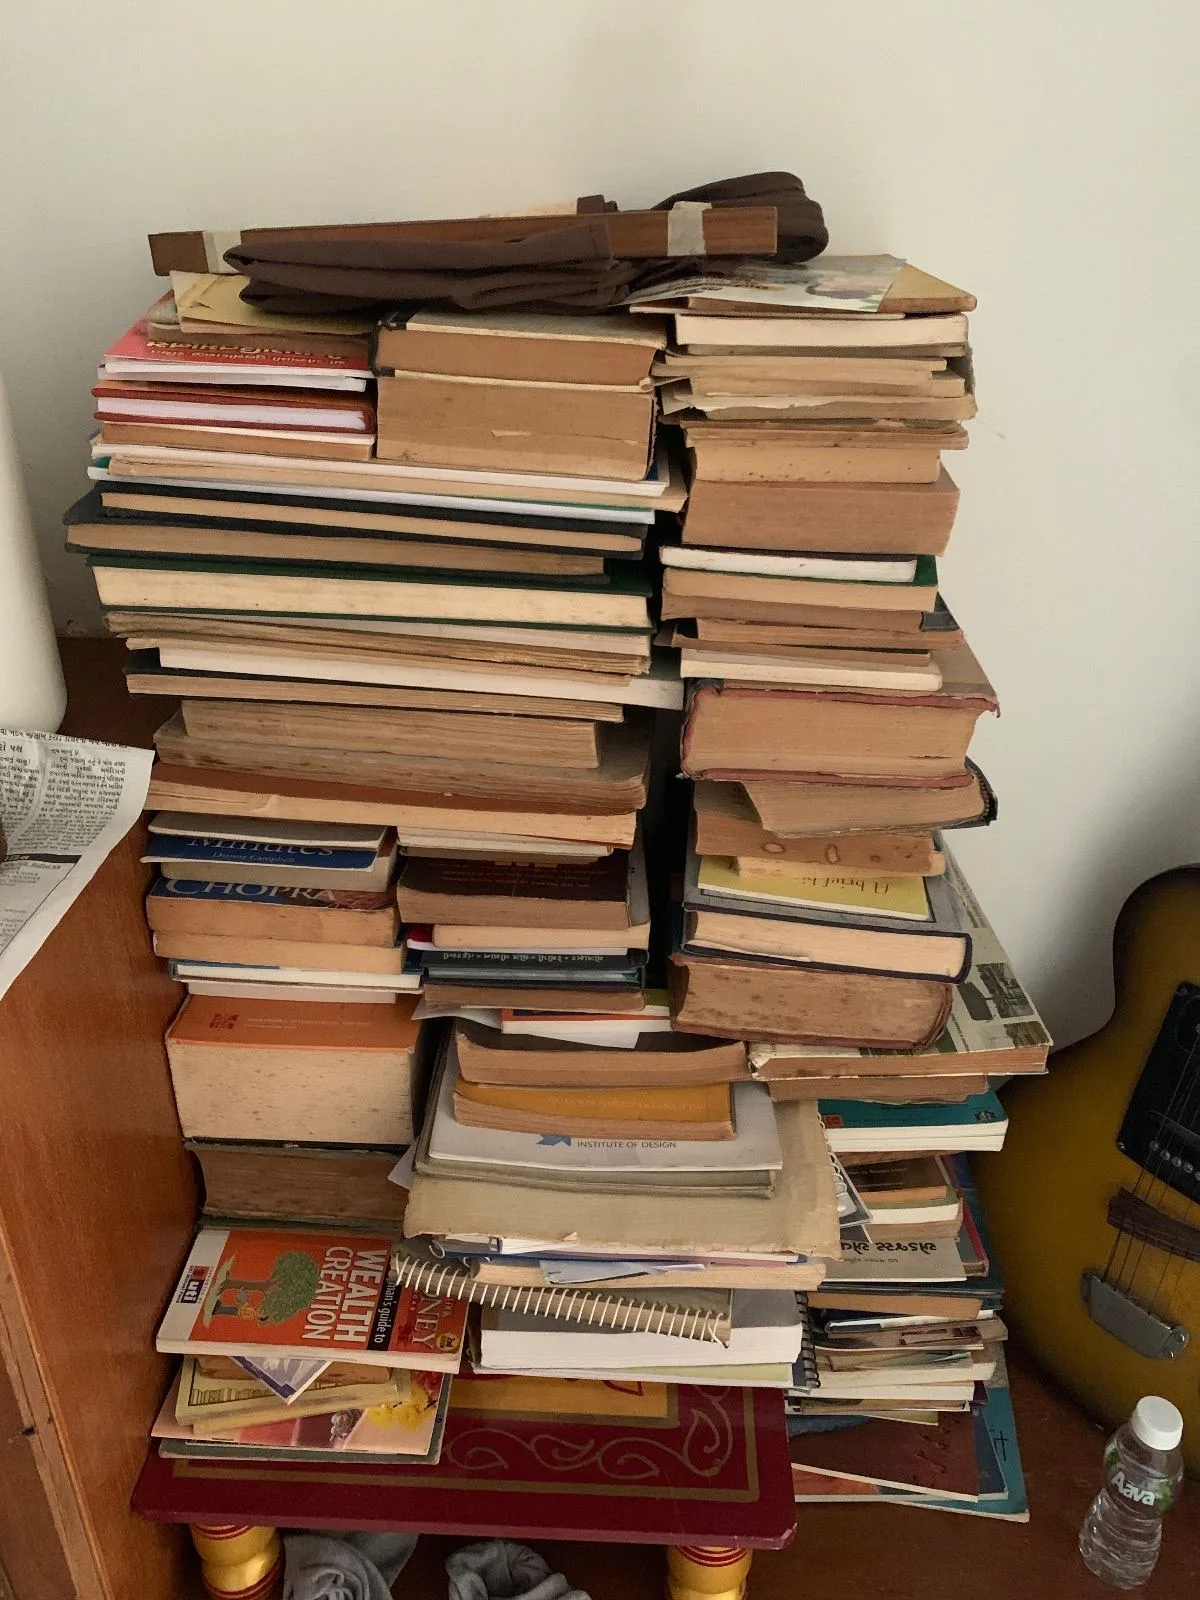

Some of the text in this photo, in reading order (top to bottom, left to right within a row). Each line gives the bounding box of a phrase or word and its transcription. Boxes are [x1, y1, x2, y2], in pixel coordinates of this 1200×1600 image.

[166, 879, 337, 901] CHOPRA
[577, 1141, 677, 1149] INSTITUTE OF DESIGN
[184, 1280, 199, 1300] uti
[301, 1245, 343, 1340] CREATION
[332, 1247, 388, 1343] WEALTH
[376, 1308, 391, 1332] guide
[411, 1290, 440, 1350] NEY
[374, 1333, 386, 1343] to
